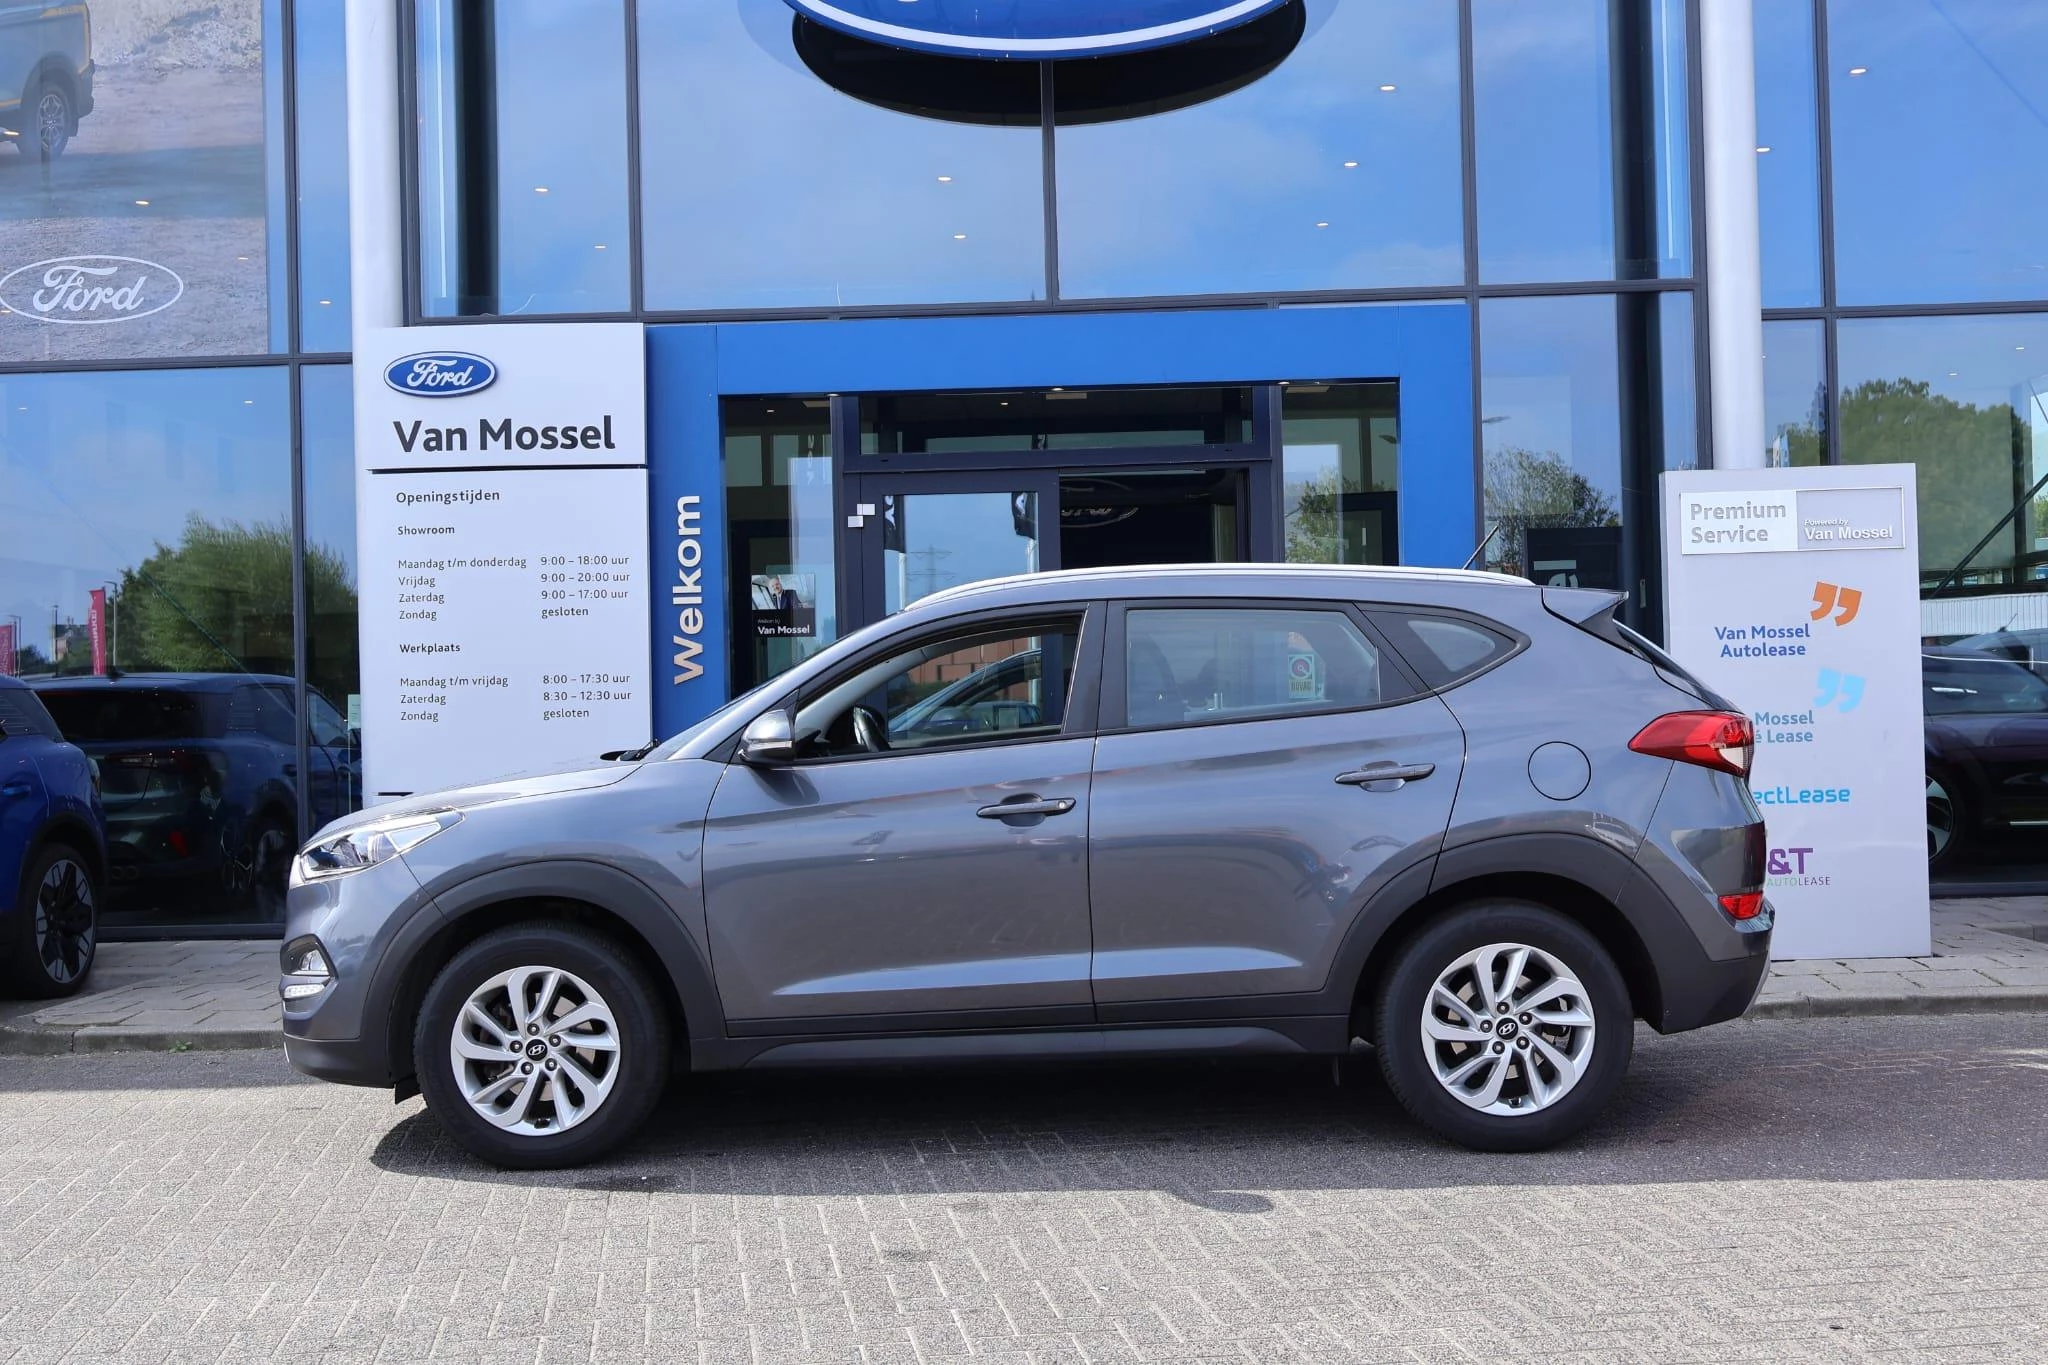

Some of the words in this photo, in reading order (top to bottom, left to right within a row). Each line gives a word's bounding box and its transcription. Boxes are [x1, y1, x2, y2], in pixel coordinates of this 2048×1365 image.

[33, 265, 148, 312] Ford
[406, 359, 474, 388] Ford
[393, 421, 467, 452] Van
[480, 415, 615, 450] Mossel
[396, 488, 500, 507] Openingstijden
[1690, 500, 1786, 521] Premium
[1804, 518, 1838, 526] Powered
[1838, 517, 1849, 526] by
[397, 525, 455, 536] Showroom
[1691, 524, 1769, 544] Service
[1804, 526, 1834, 540] Van
[1838, 523, 1893, 539] Mossel
[398, 558, 445, 571] Maandag
[447, 557, 467, 568] t/m
[469, 556, 527, 569] donderdag
[540, 555, 566, 566] 9:00
[577, 555, 608, 565] 18:00
[611, 556, 630, 565] uur
[398, 575, 436, 589] Vrijdag
[540, 572, 566, 583] 9:00
[577, 572, 610, 582] 20:00
[612, 573, 630, 582] uur
[399, 591, 445, 605] Zaterdag
[541, 589, 566, 600] 9:00
[578, 589, 608, 600] 17:00
[610, 590, 629, 599] uur
[672, 495, 704, 685] Welkom
[399, 609, 437, 622] Zondag
[541, 606, 589, 620] gesloten
[757, 626, 776, 635] Van
[777, 624, 810, 634] Mossel
[1714, 626, 1747, 641] Van
[1751, 622, 1811, 640] Mossel
[399, 642, 461, 656] Werkplaats
[1720, 641, 1806, 658] Autolease
[400, 676, 447, 689] Maandag
[449, 675, 469, 686] t/m
[471, 675, 509, 688] vrijdag
[542, 674, 568, 685] 8:00
[579, 673, 609, 684] 17:30
[612, 674, 631, 683] uur
[400, 693, 447, 706] Zaterdag
[543, 691, 568, 702] 8:30
[580, 690, 610, 701] 12:30
[613, 691, 632, 700] uur
[400, 710, 439, 723] Zondag
[543, 707, 590, 721] gesloten
[1754, 709, 1815, 726] Mossel
[1767, 729, 1814, 744] Lease
[1753, 786, 1851, 805] ectLease
[1767, 847, 1814, 876] &T
[1767, 876, 1831, 887] AUTOLEASE
